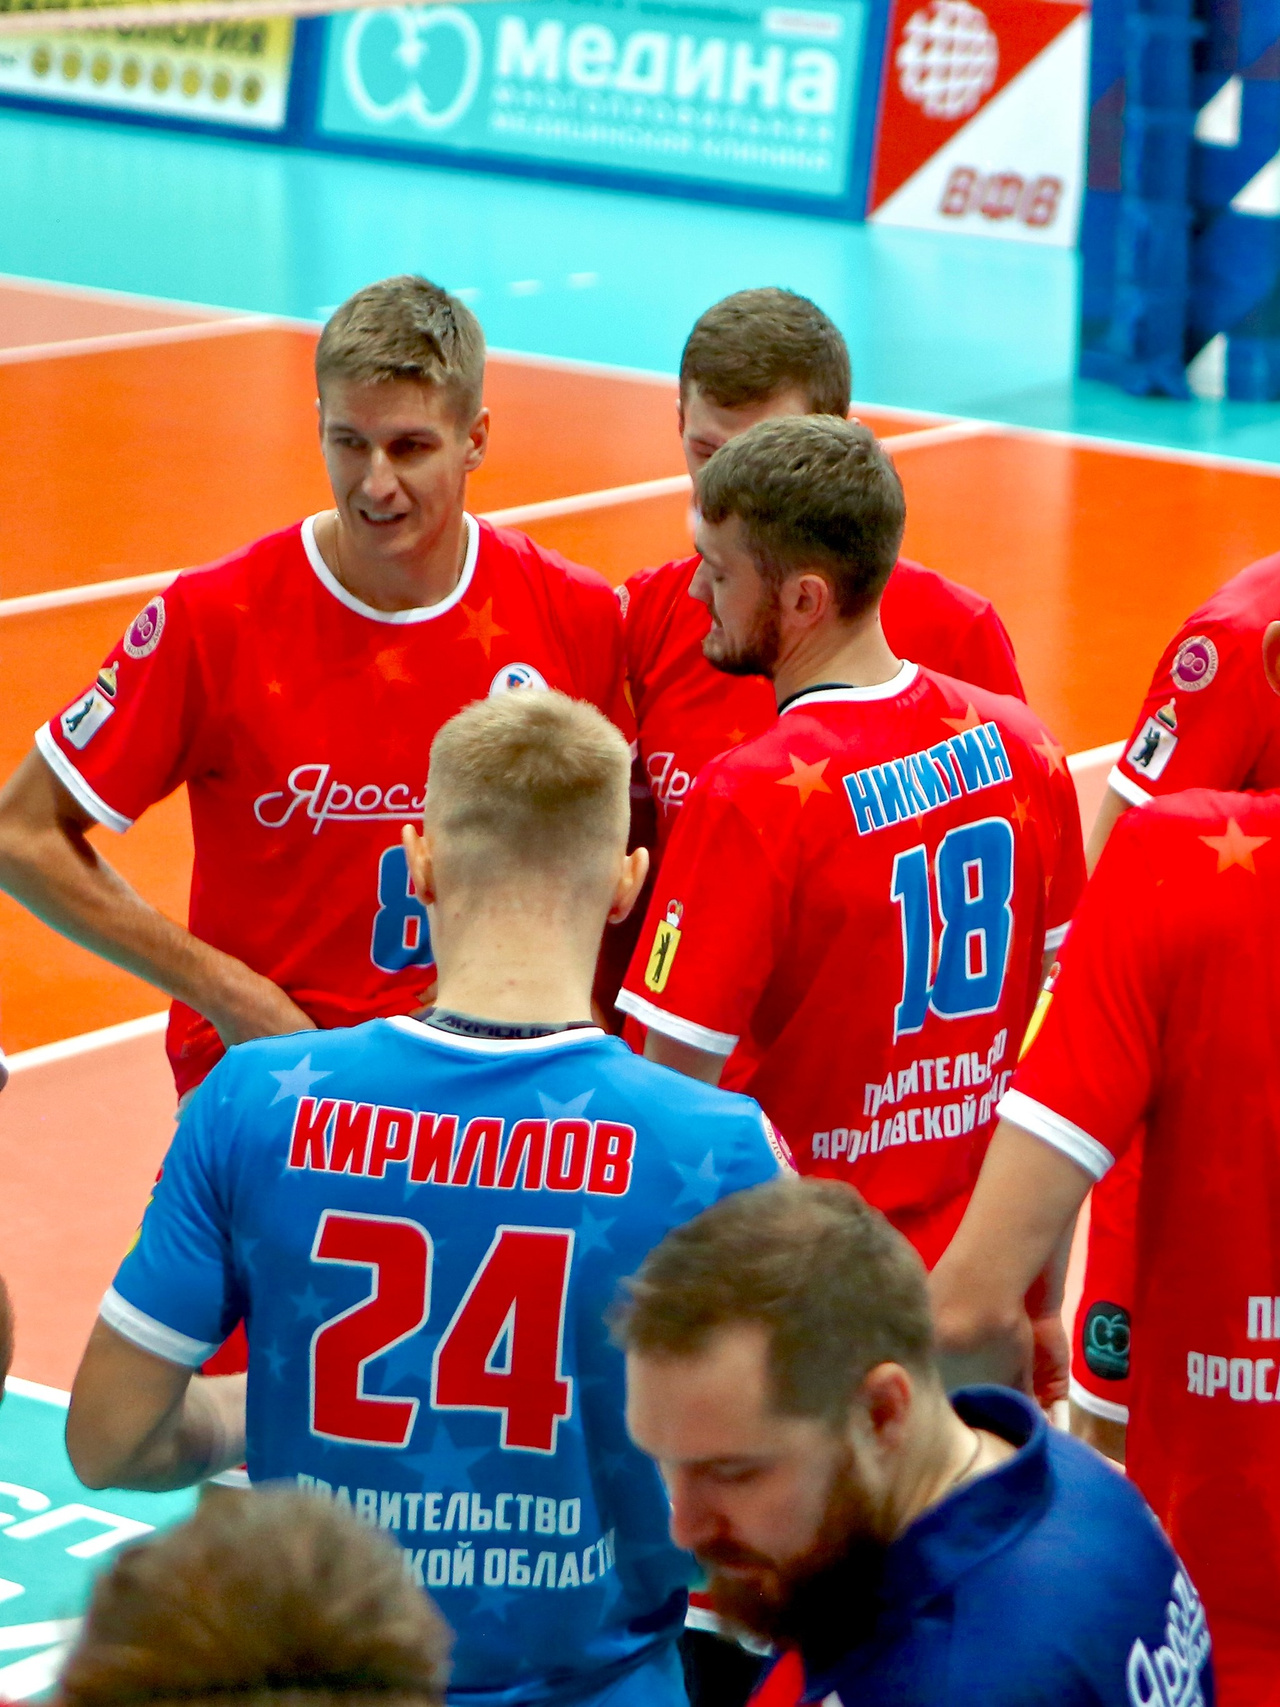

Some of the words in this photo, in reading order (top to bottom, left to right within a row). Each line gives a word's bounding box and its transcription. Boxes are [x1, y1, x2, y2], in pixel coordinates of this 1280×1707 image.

[496, 14, 838, 115] медина
[938, 165, 1063, 229] ВФВ
[646, 751, 697, 818] Яр
[842, 722, 1014, 837] НИКИТИН
[371, 845, 436, 973] 8
[891, 816, 1015, 1044] 18
[287, 1096, 637, 1197] КИРИЛЛОВ
[310, 1208, 575, 1454] 24
